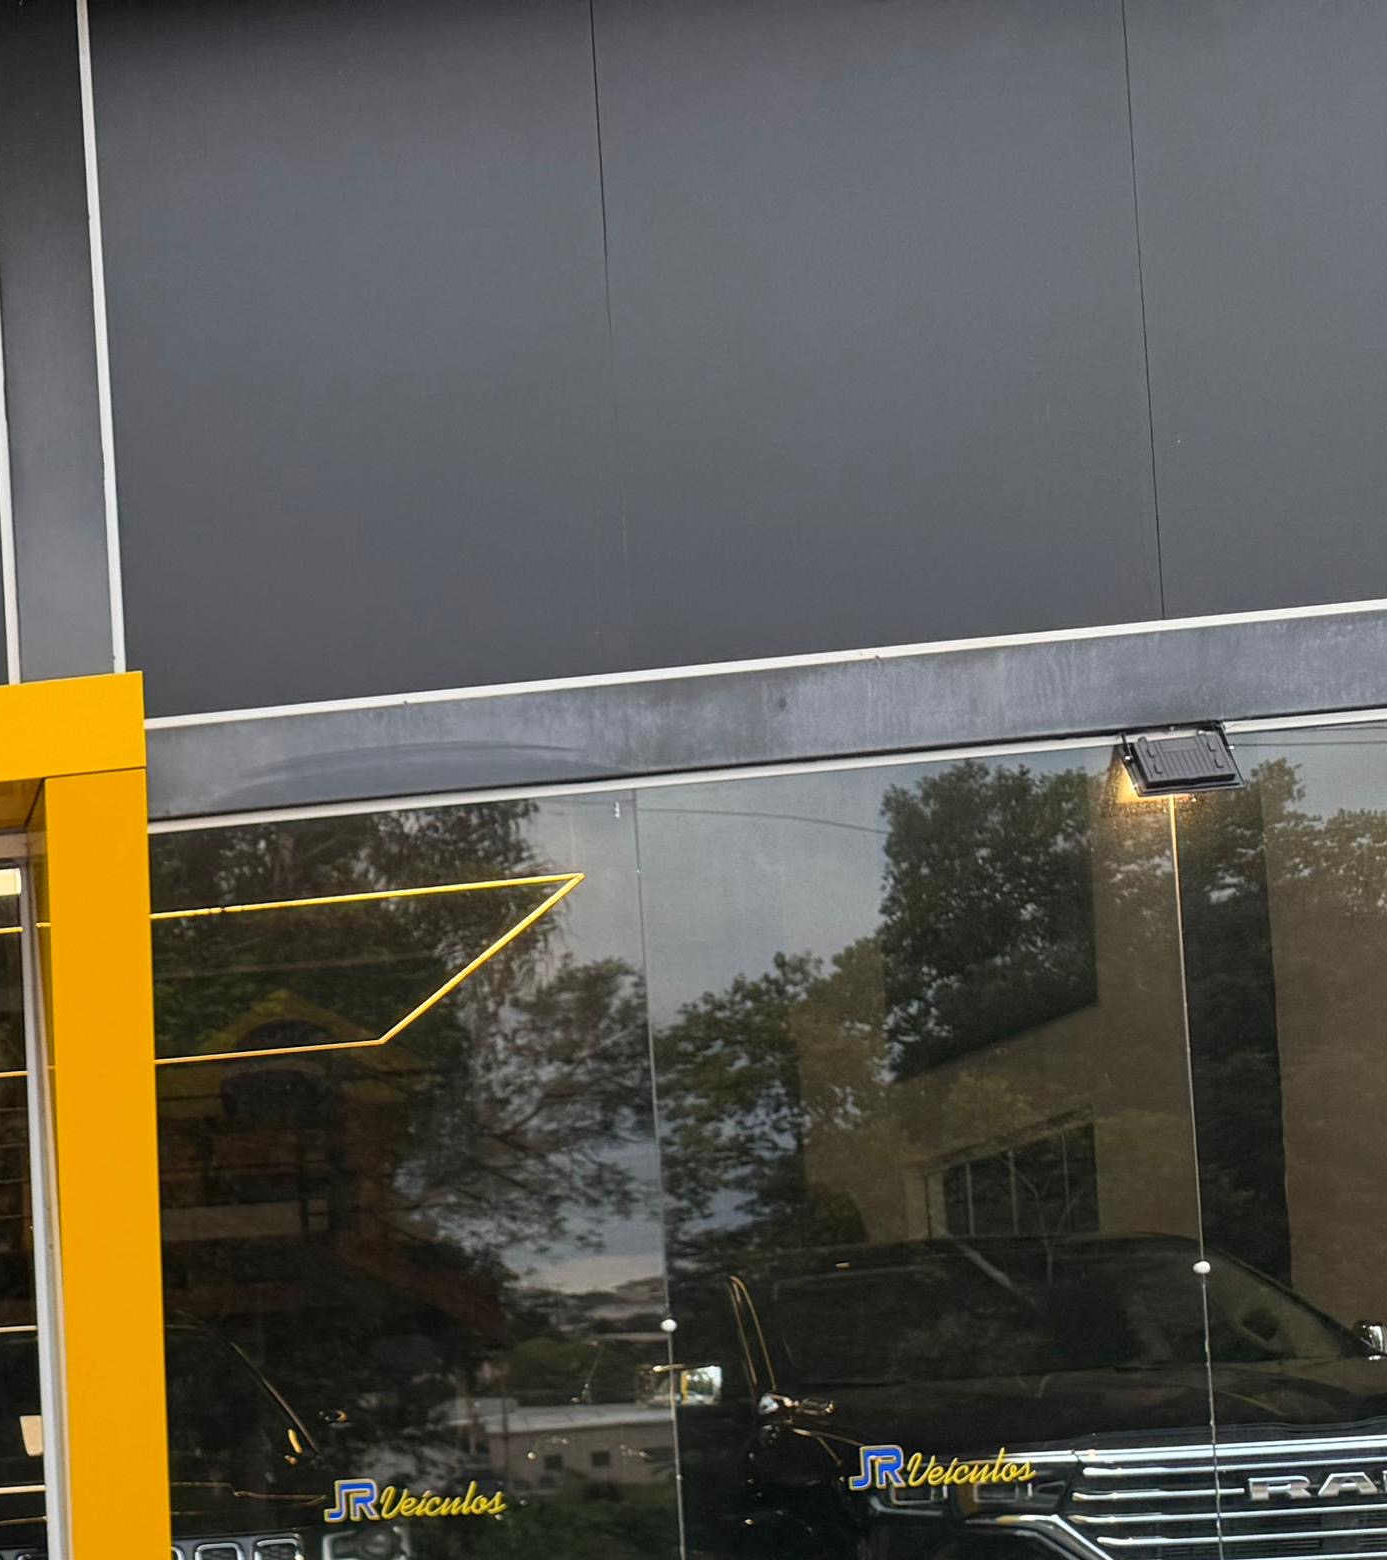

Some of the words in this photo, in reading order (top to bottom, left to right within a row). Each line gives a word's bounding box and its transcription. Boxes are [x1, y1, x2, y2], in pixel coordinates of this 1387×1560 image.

[848, 1445, 907, 1491] JR
[1248, 1470, 1387, 1501] RA
[324, 1478, 380, 1523] JR
